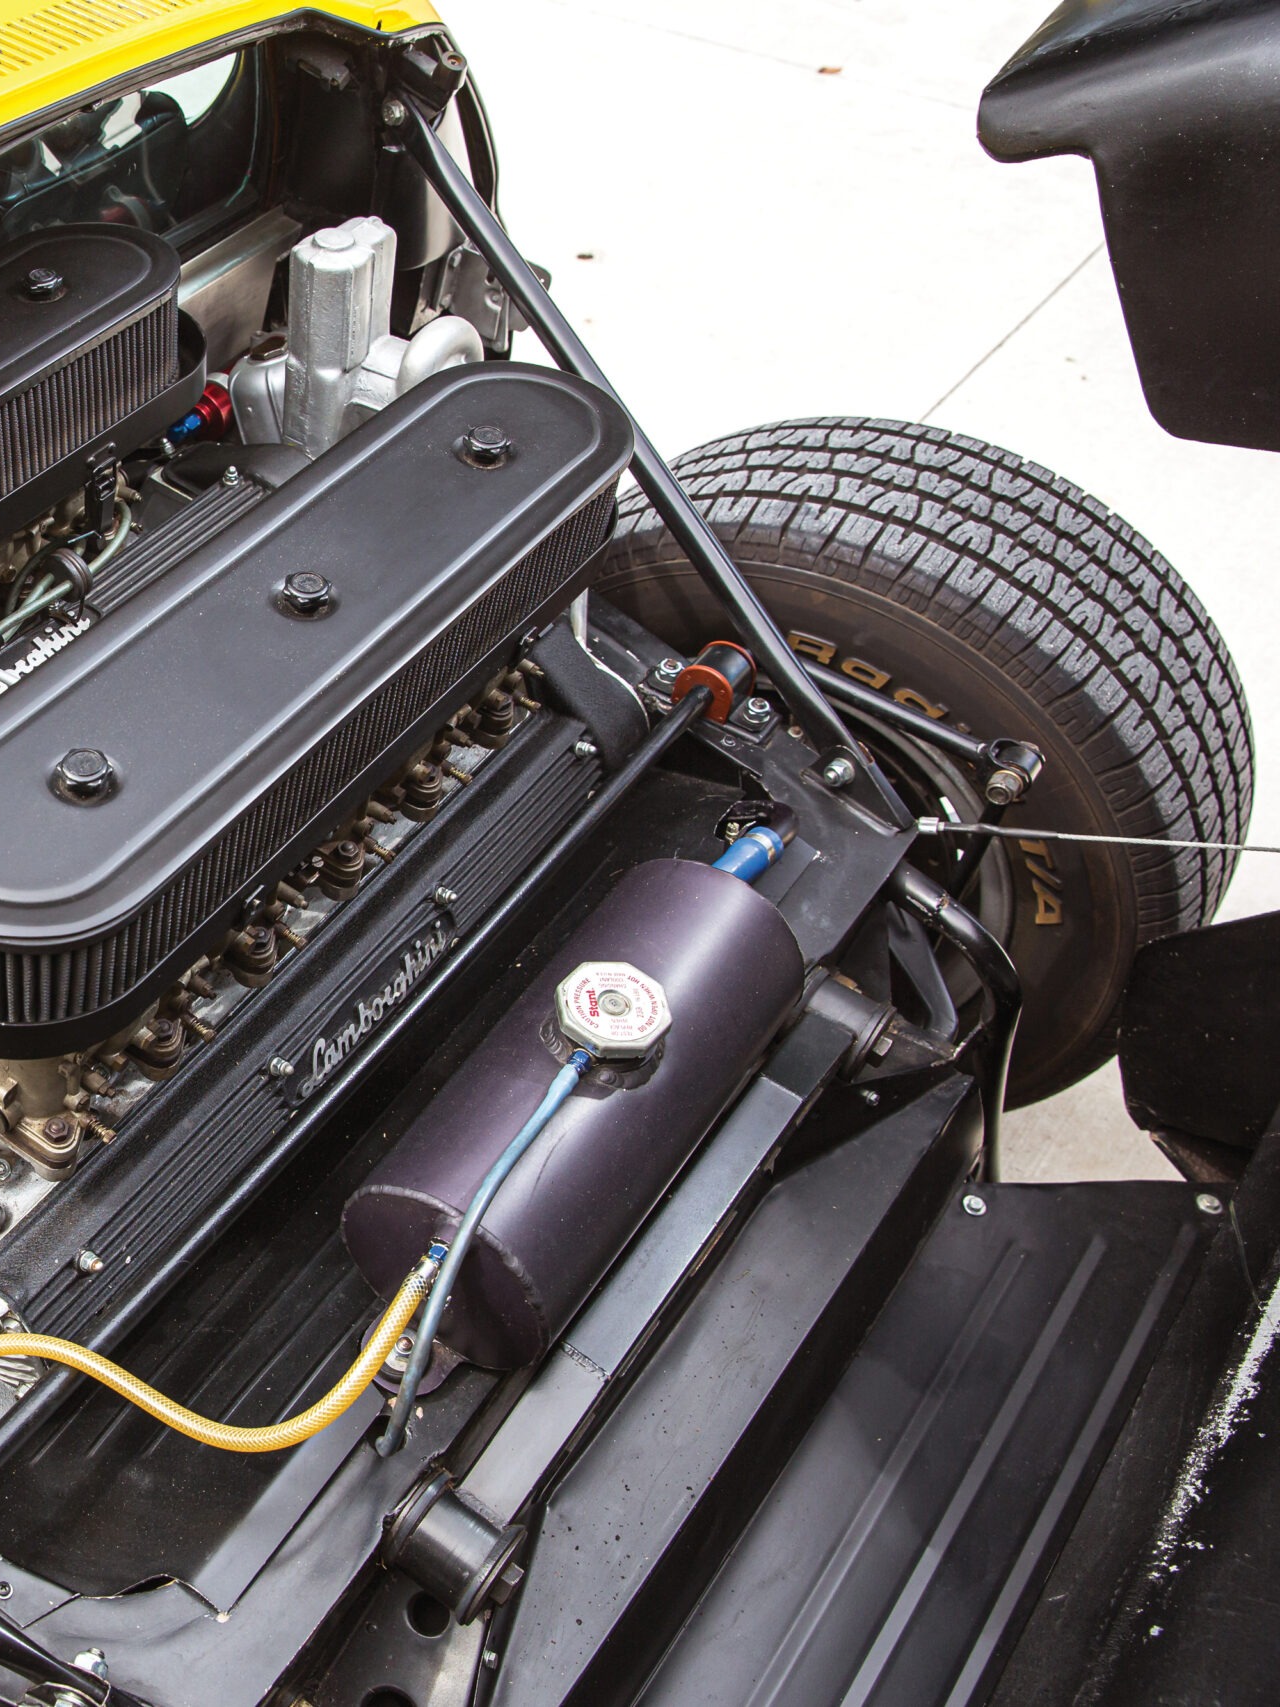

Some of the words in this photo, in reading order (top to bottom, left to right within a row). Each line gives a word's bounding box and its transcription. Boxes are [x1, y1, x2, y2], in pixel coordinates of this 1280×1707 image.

[627, 975, 641, 984] HOT
[573, 977, 591, 1004] PRESSURE
[640, 983, 656, 1000] WHEN
[302, 920, 447, 1097] Lamborghini
[586, 988, 600, 1017] Stant
[651, 1000, 659, 1016] OPEN
[575, 1005, 599, 1029] CAUTION
[645, 1015, 656, 1027] NOT
